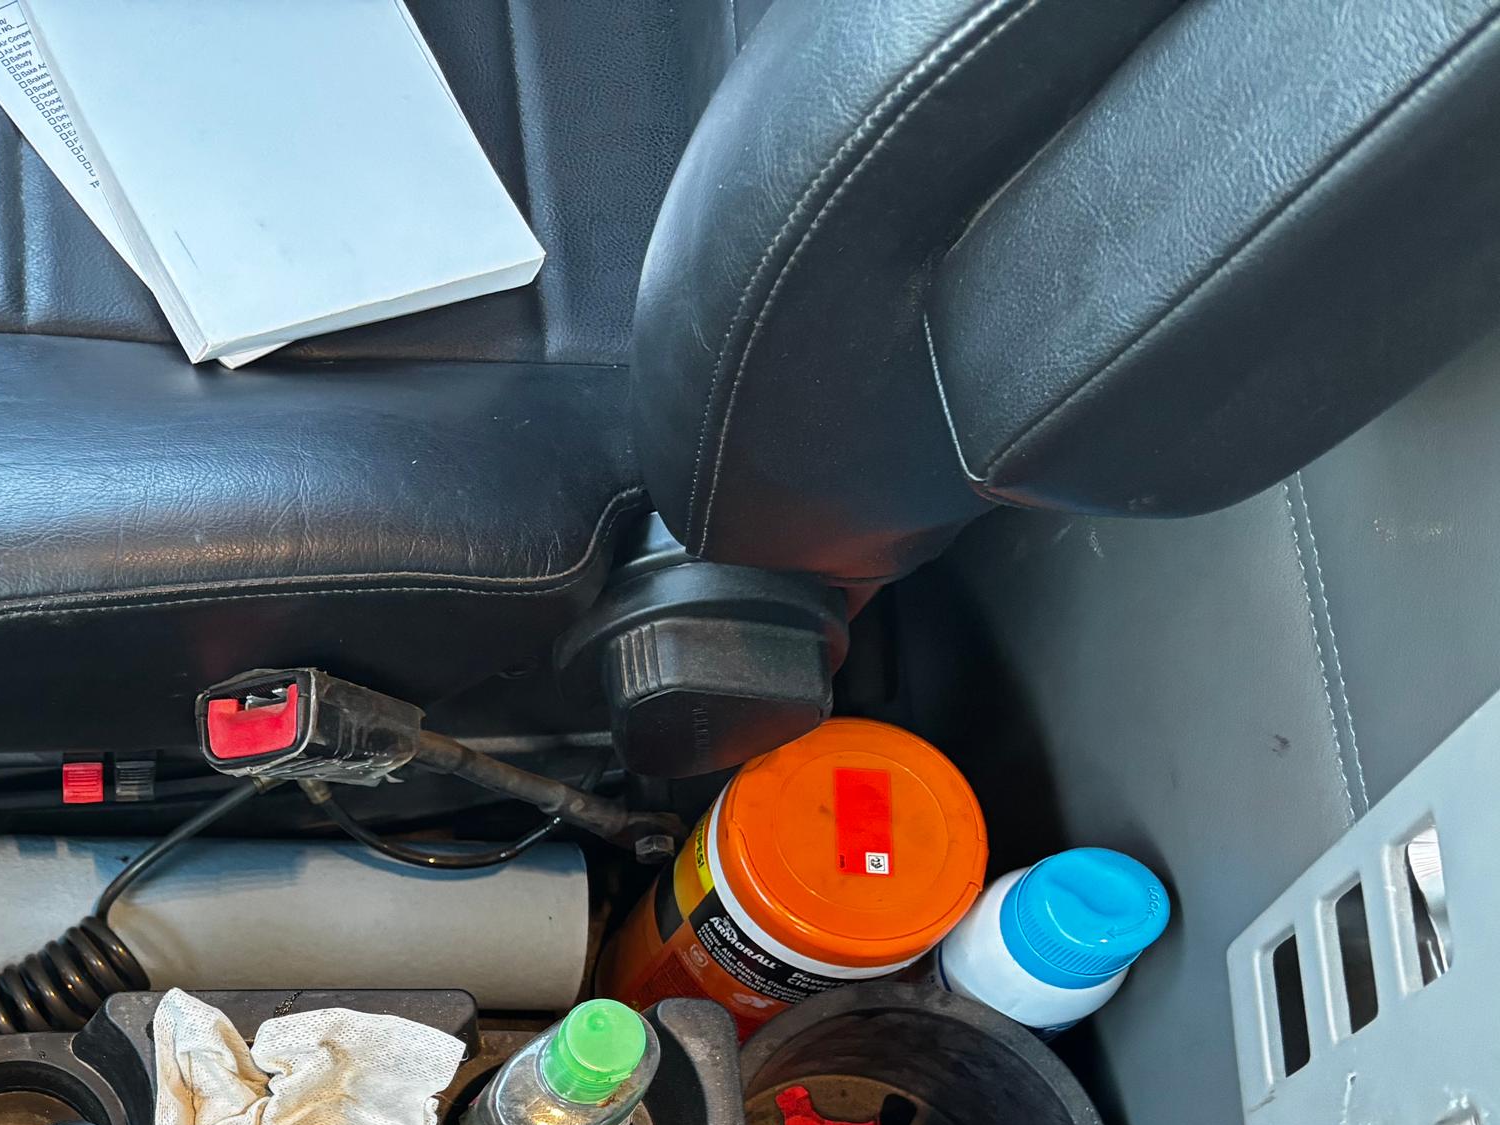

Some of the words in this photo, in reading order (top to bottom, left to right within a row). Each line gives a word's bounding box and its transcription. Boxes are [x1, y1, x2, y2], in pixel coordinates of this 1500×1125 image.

[1, 24, 15, 34] NO.
[4, 47, 14, 55] Air
[13, 40, 31, 50] Lines
[9, 50, 32, 62] Battery
[15, 60, 32, 70] Body
[696, 929, 712, 951] fresh
[711, 951, 738, 978] orange
[737, 973, 761, 991] scent
[700, 926, 715, 947] from
[713, 943, 754, 983] sunscreen,
[703, 922, 724, 949] Armor
[736, 960, 767, 983] Orange
